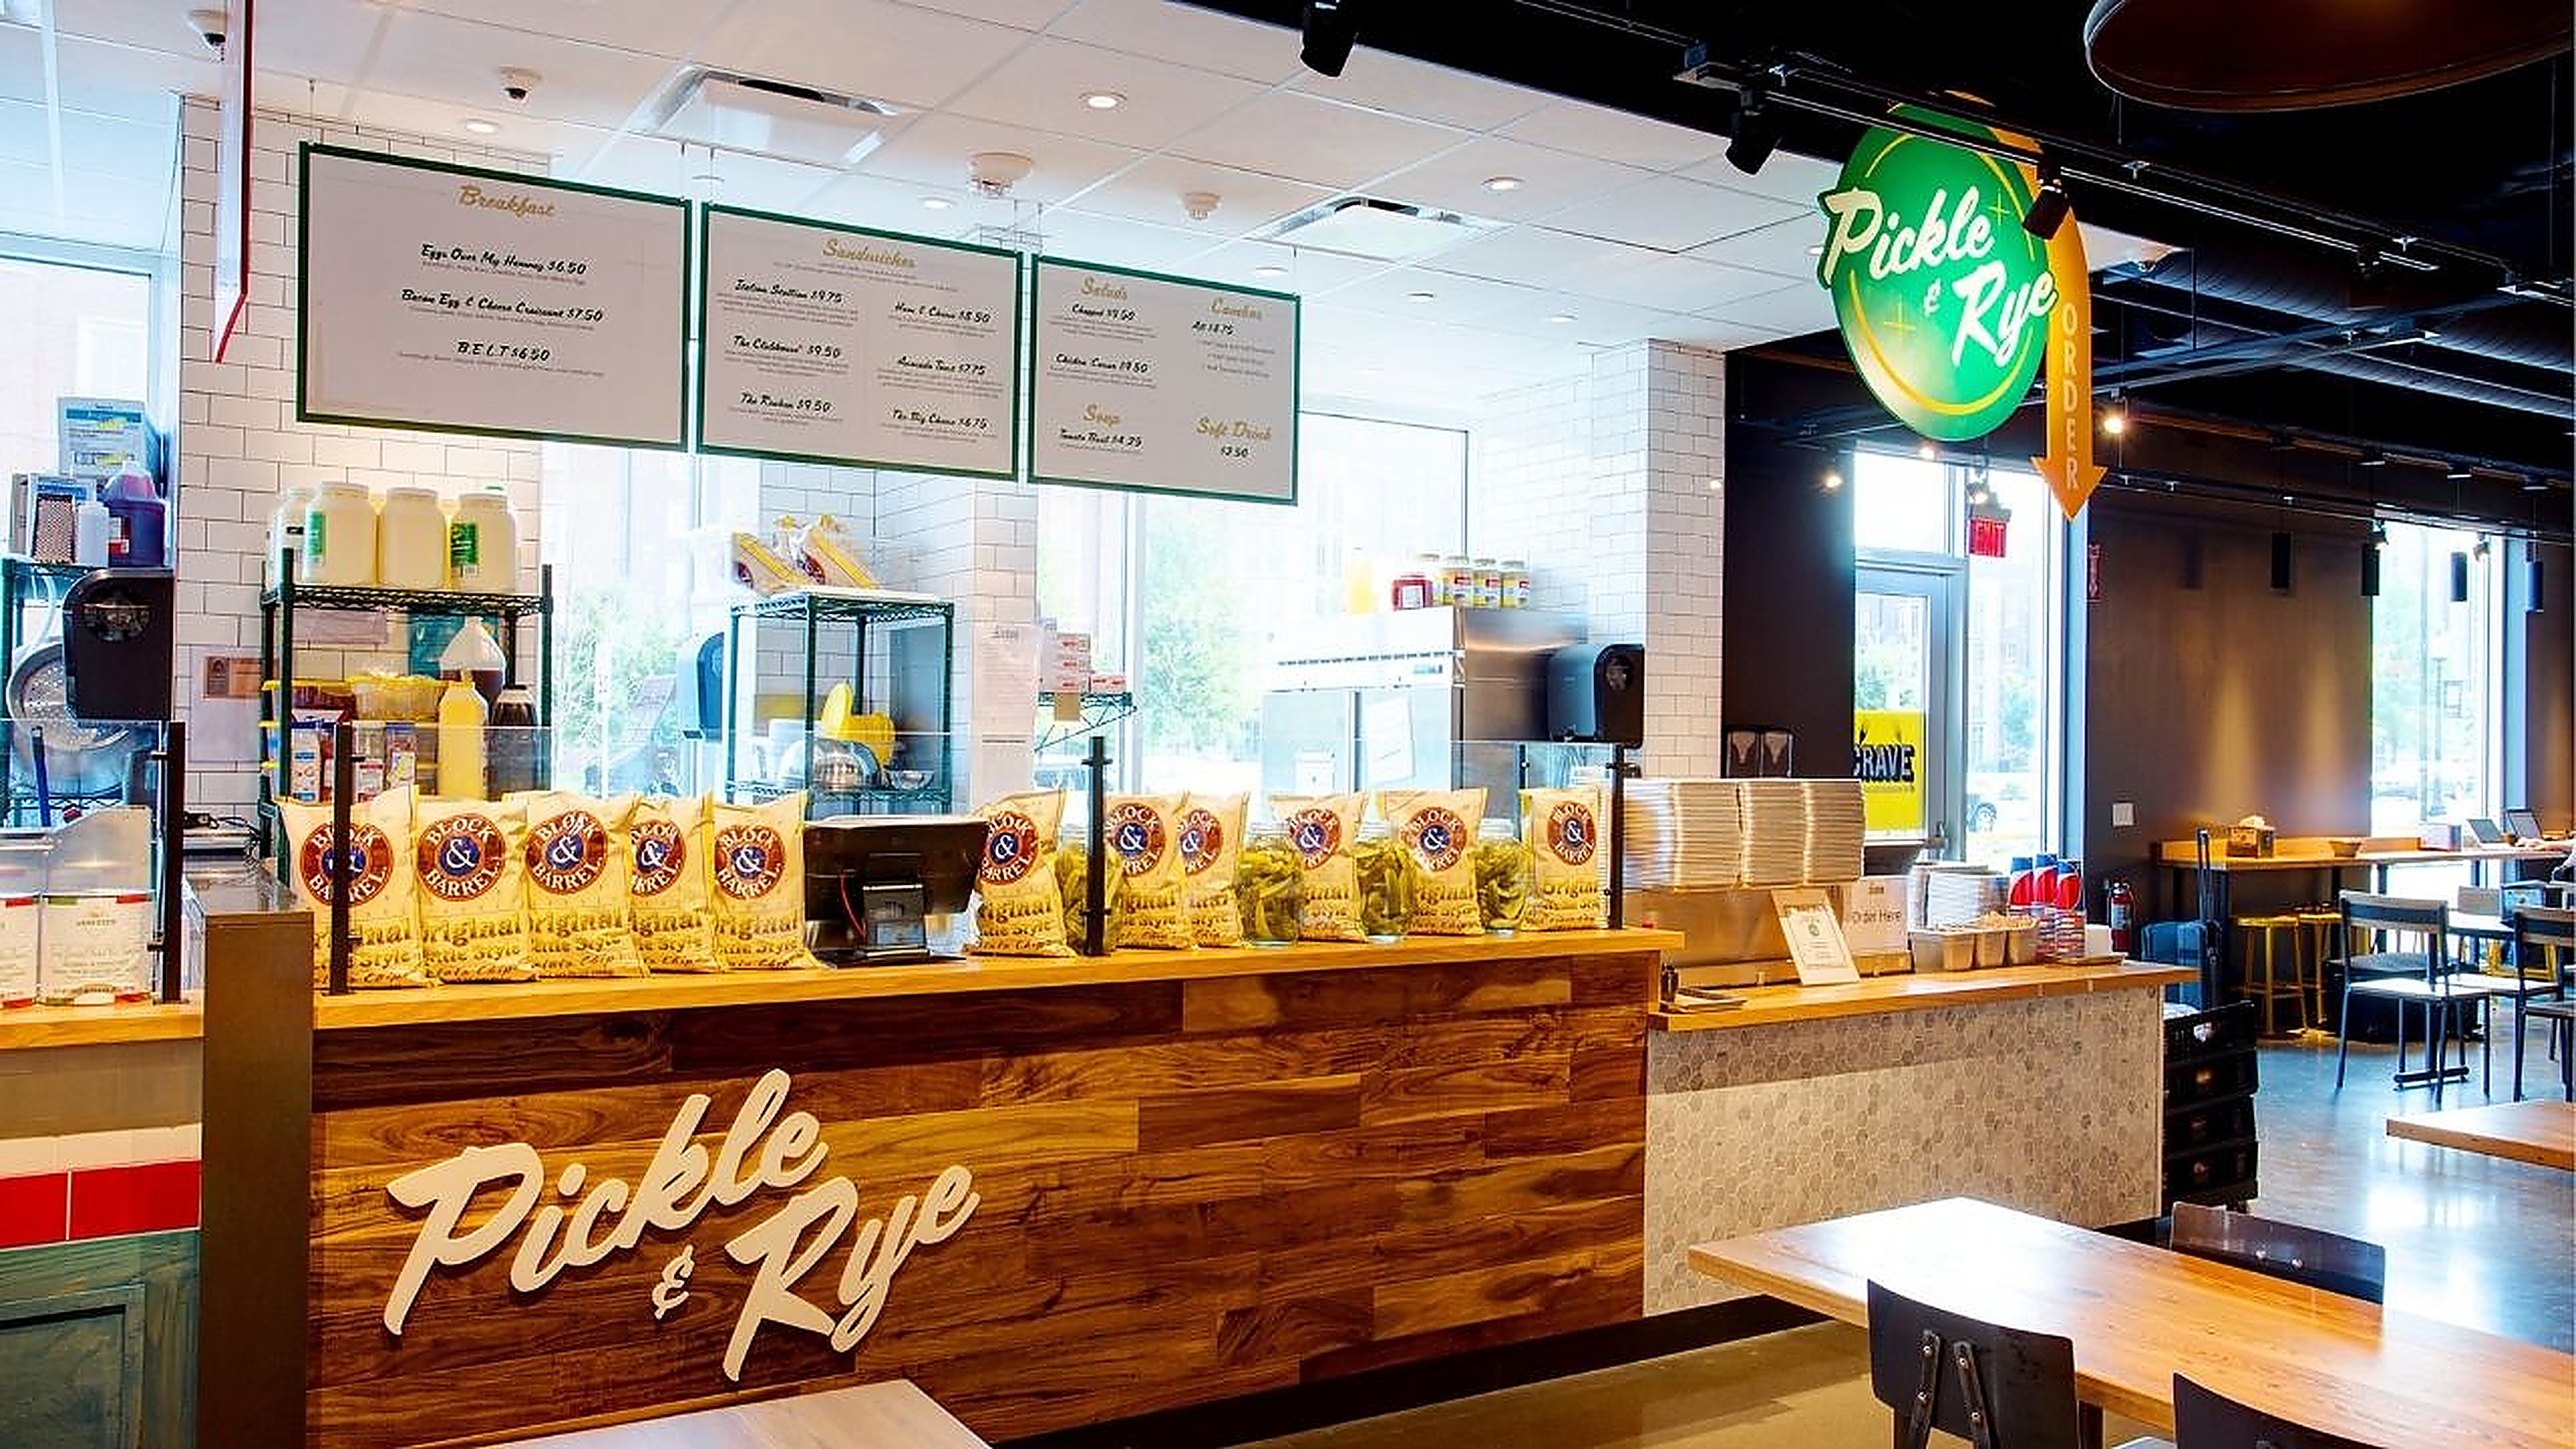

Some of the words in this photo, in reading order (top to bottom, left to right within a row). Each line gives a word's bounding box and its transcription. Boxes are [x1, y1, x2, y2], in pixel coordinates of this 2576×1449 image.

[457, 184, 555, 217] Breakfast
[1823, 186, 1994, 286] Pickle
[480, 251, 500, 266] My
[822, 239, 916, 268] Sandwiches
[1923, 278, 1941, 317] &
[1951, 260, 2057, 368] Rye
[2062, 303, 2079, 492] ORDER
[426, 816, 496, 846] BLOCK
[537, 812, 600, 841] BLOCK
[723, 827, 775, 848] BLOCK
[1120, 825, 1144, 851] &
[1299, 825, 1322, 849] &
[1424, 828, 1446, 850] &
[1566, 820, 1585, 843] &
[445, 839, 476, 869] &
[551, 835, 579, 863] &
[641, 841, 663, 866] &
[995, 834, 1016, 859] &
[1182, 830, 1201, 853] &
[533, 858, 601, 891] BARREL
[736, 847, 761, 873] &
[309, 871, 385, 903] BAREL
[425, 858, 499, 898] BARREL
[717, 863, 781, 898] BARREL
[383, 1067, 828, 1336] Pickle
[652, 1244, 695, 1320] &
[722, 1164, 981, 1383] Rye
